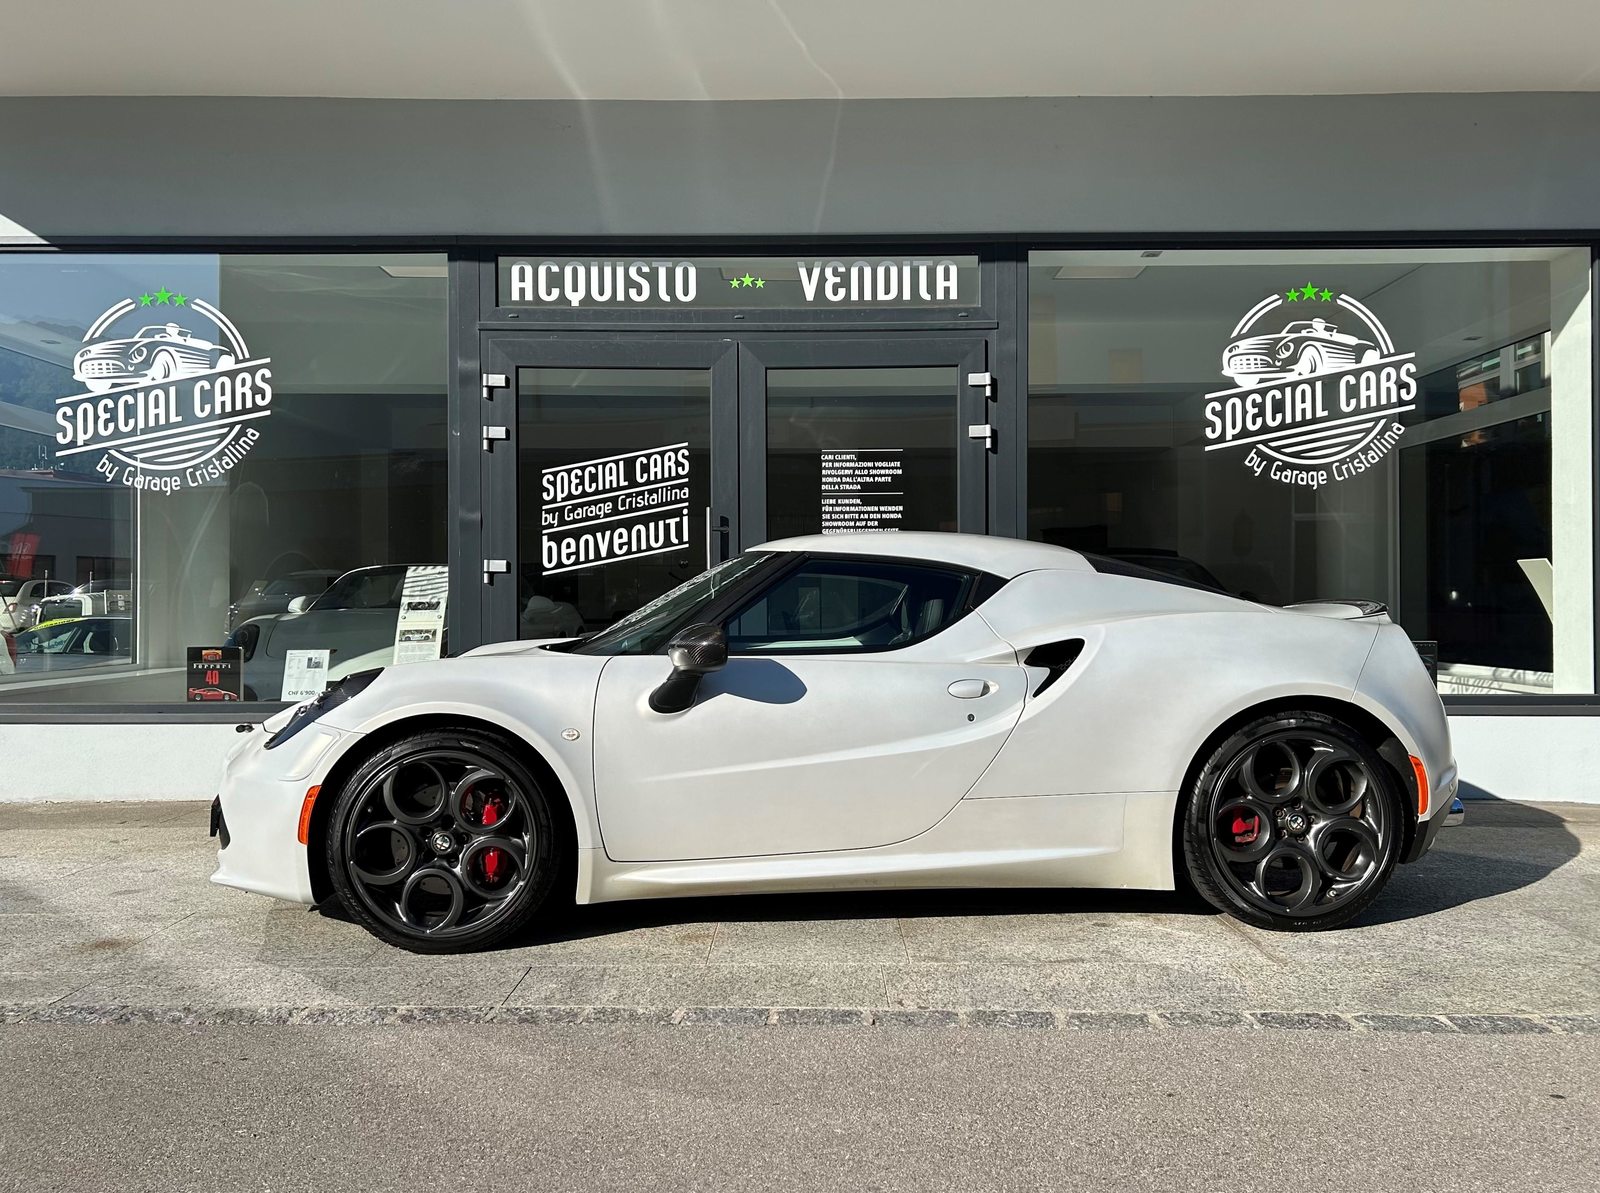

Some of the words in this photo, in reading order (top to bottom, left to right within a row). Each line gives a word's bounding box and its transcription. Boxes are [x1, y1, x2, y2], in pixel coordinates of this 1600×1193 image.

[510, 260, 698, 307] ACQUISTO
[796, 260, 958, 301] VENDITA
[55, 385, 183, 446] SPECIAL
[193, 368, 272, 418] CARS
[1204, 380, 1329, 441] SPECIAL
[1339, 362, 1418, 413] CARS
[96, 454, 119, 482] by
[122, 466, 182, 495] Garage
[186, 427, 260, 487] Cristallina
[542, 460, 628, 502] SPECIAL
[635, 448, 690, 483] CARS
[1244, 448, 1267, 476] by
[1270, 461, 1328, 490] Garage
[1332, 421, 1406, 481] Cristallina
[541, 510, 559, 527] by
[564, 501, 612, 521] Garage
[618, 486, 689, 511] Cristallina
[541, 508, 689, 569] benvenuti
[205, 670, 219, 685] 40
